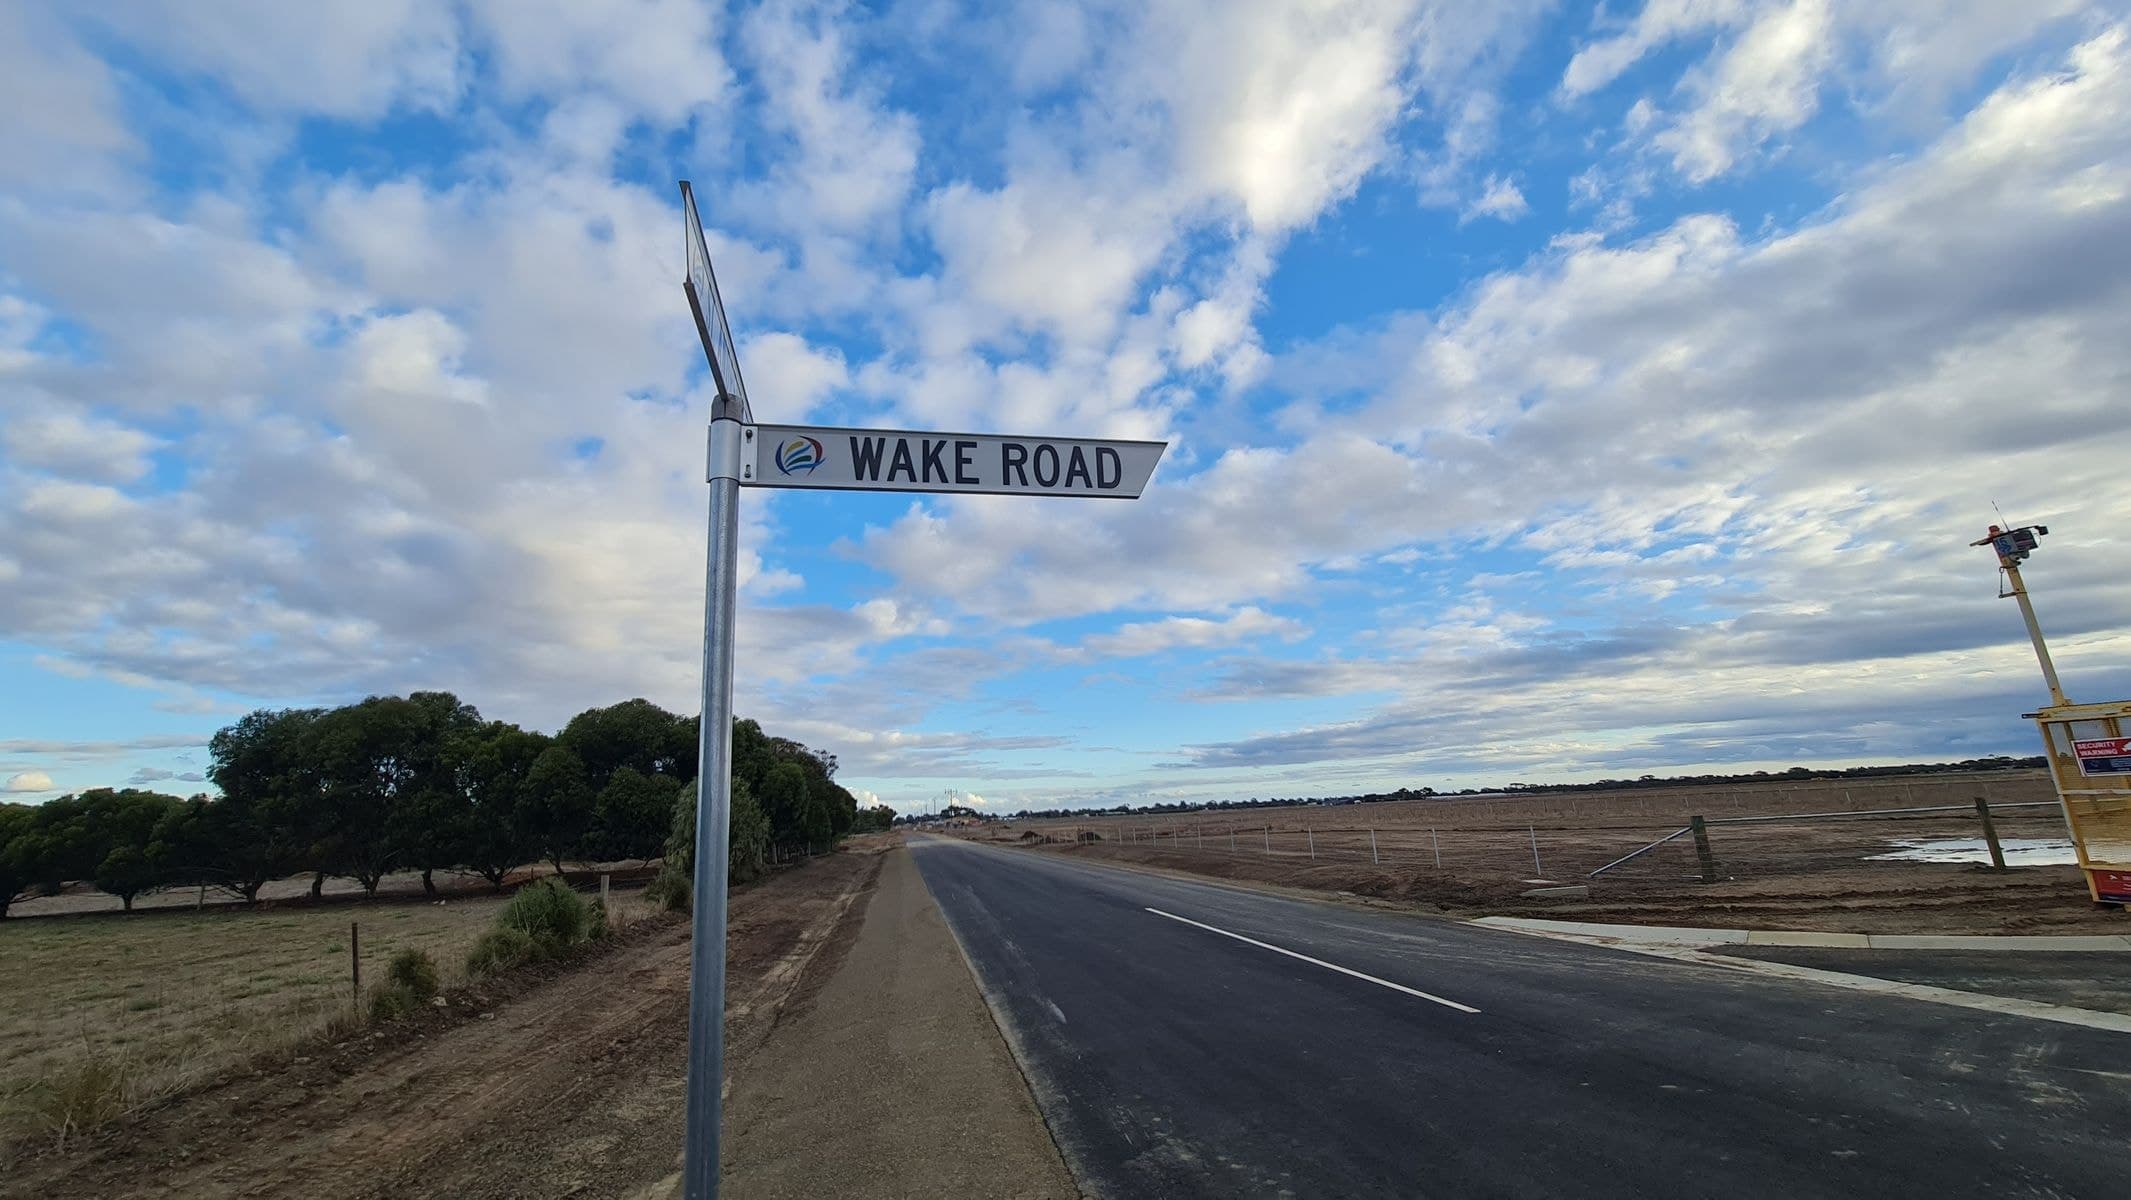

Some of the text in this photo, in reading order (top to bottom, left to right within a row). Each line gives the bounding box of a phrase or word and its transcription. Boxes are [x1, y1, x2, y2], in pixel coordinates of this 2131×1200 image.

[850, 436, 1122, 489] WAKE ROAD
[2076, 741, 2115, 750] SECURITY
[2079, 748, 2118, 756] WARNING
